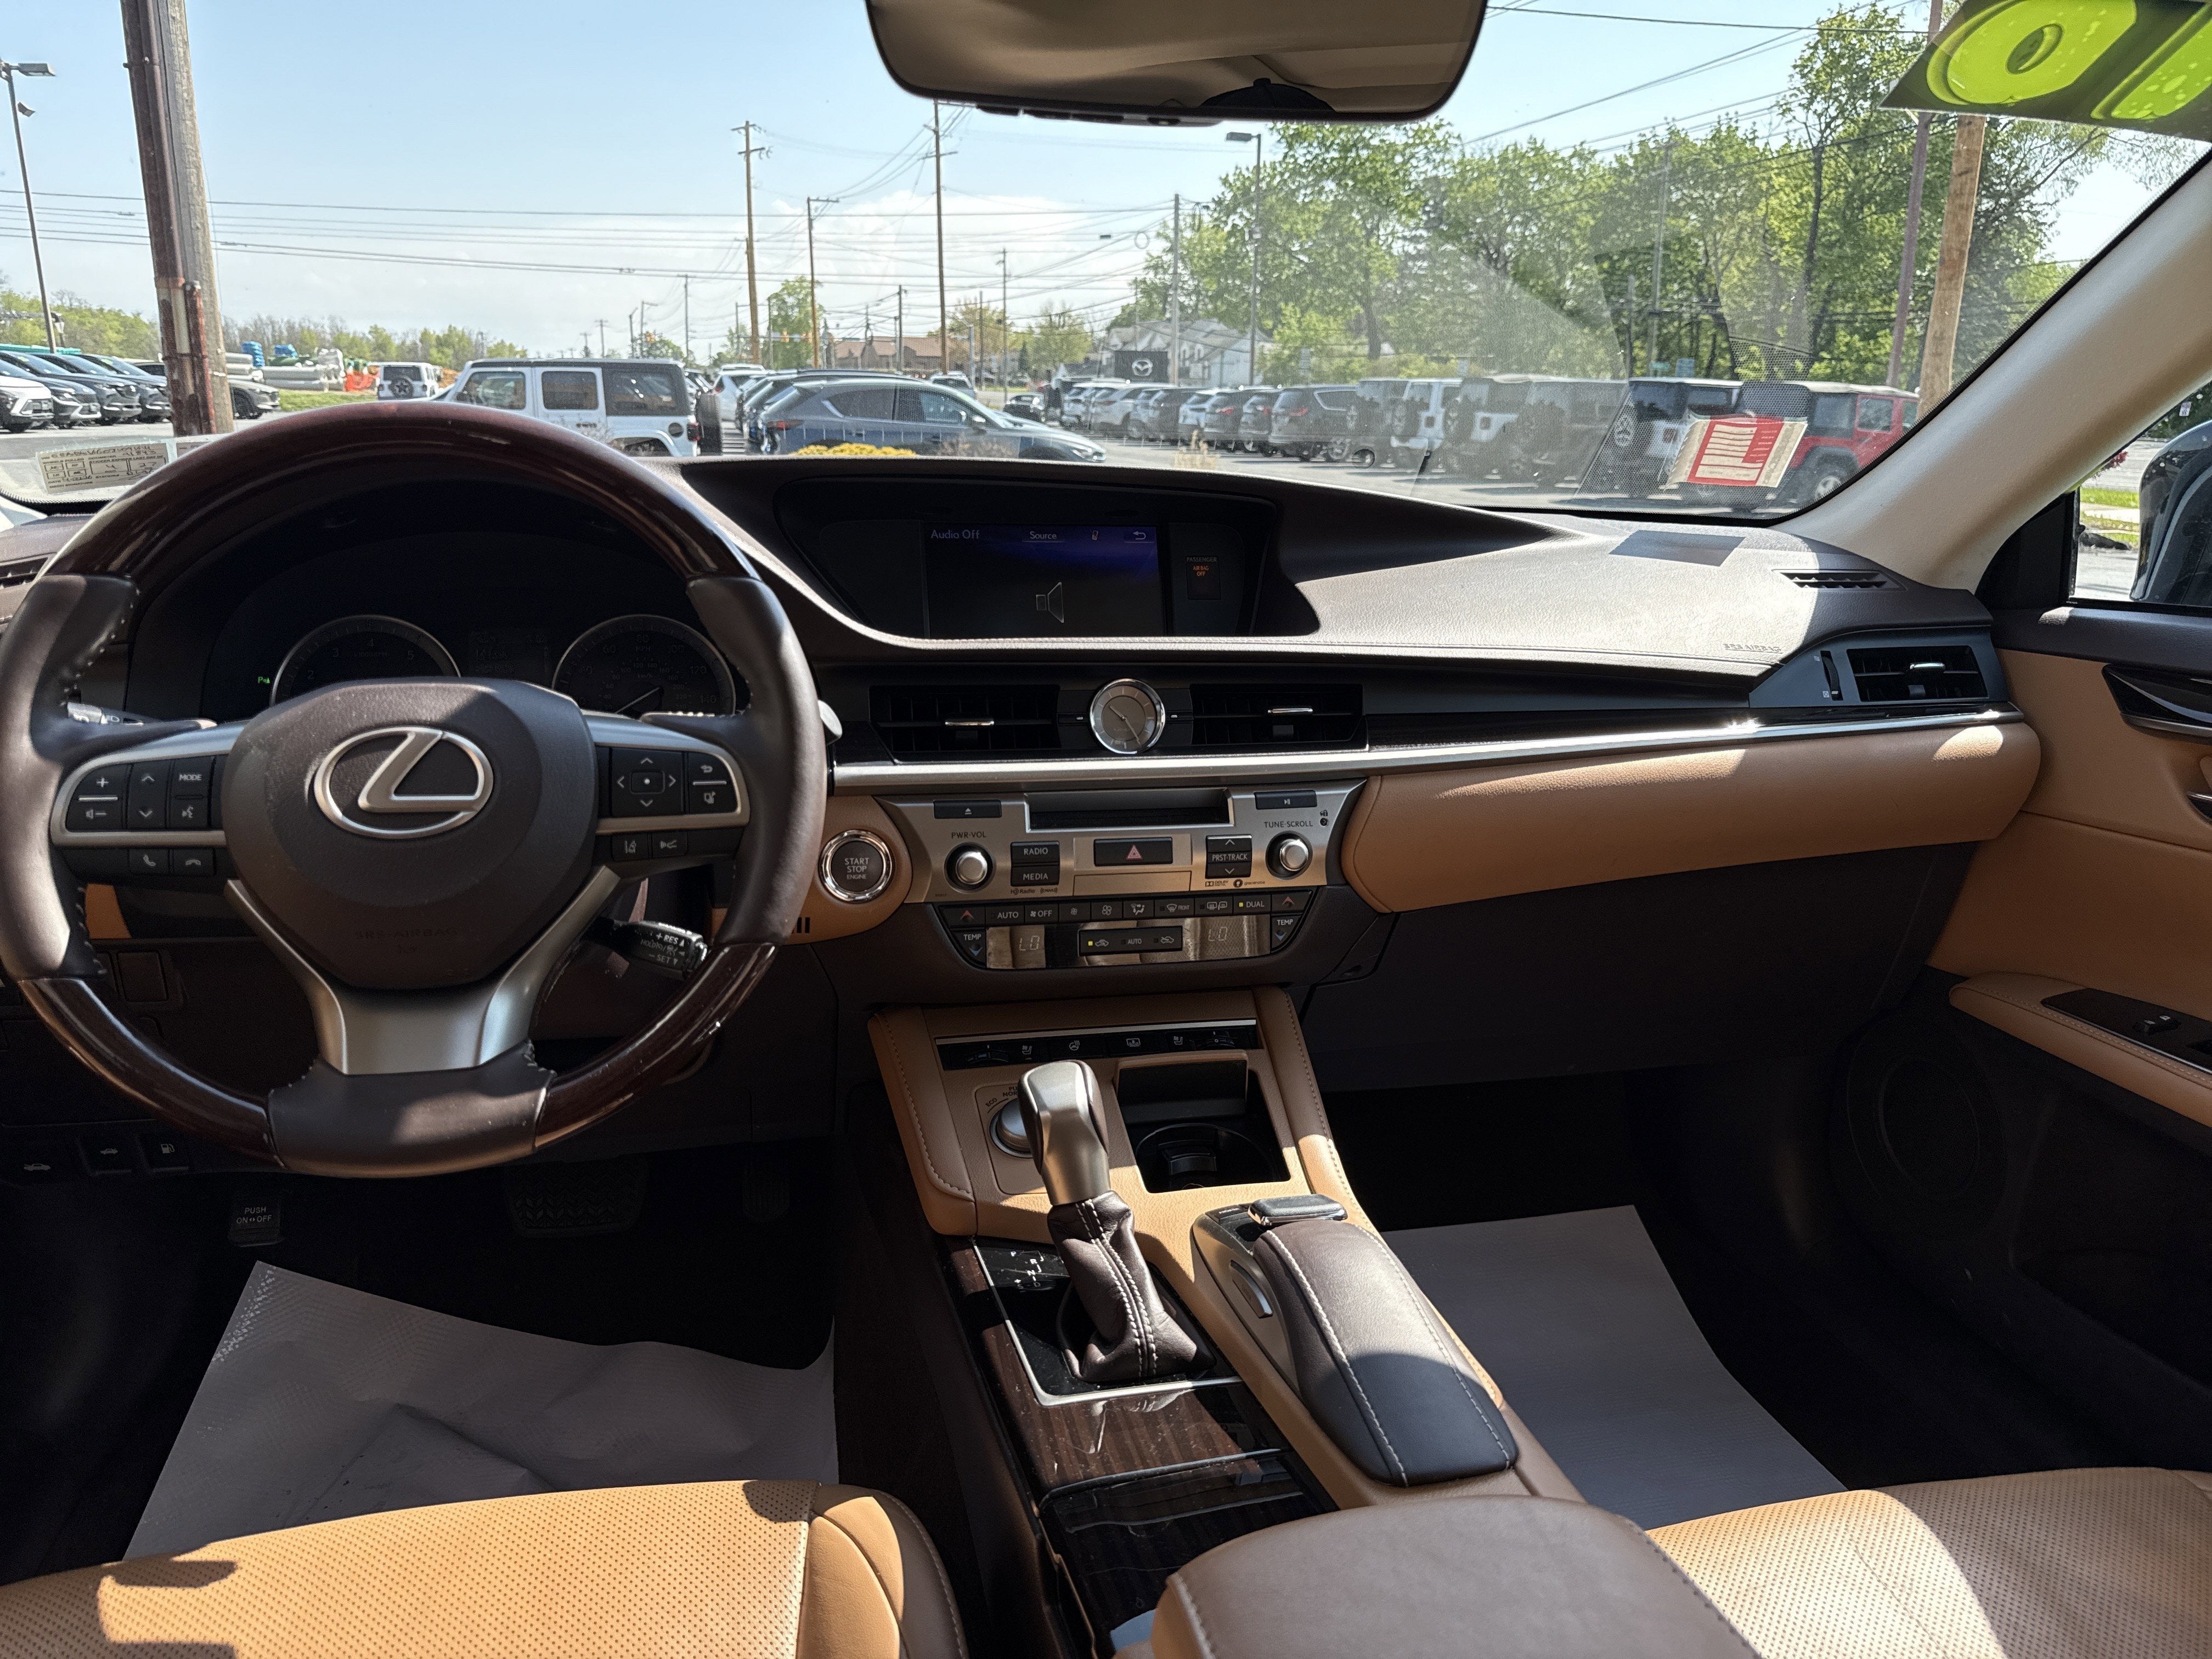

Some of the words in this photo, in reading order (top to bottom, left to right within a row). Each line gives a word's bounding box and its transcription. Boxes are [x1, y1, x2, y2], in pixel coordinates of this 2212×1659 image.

[931, 529, 960, 539] Audio
[962, 529, 980, 539] Off
[1029, 531, 1057, 540] Source
[1023, 872, 1048, 881] MEDIA
[1037, 910, 1053, 918] OFF
[985, 1098, 997, 1107] ECO
[244, 1206, 267, 1215] PUSH
